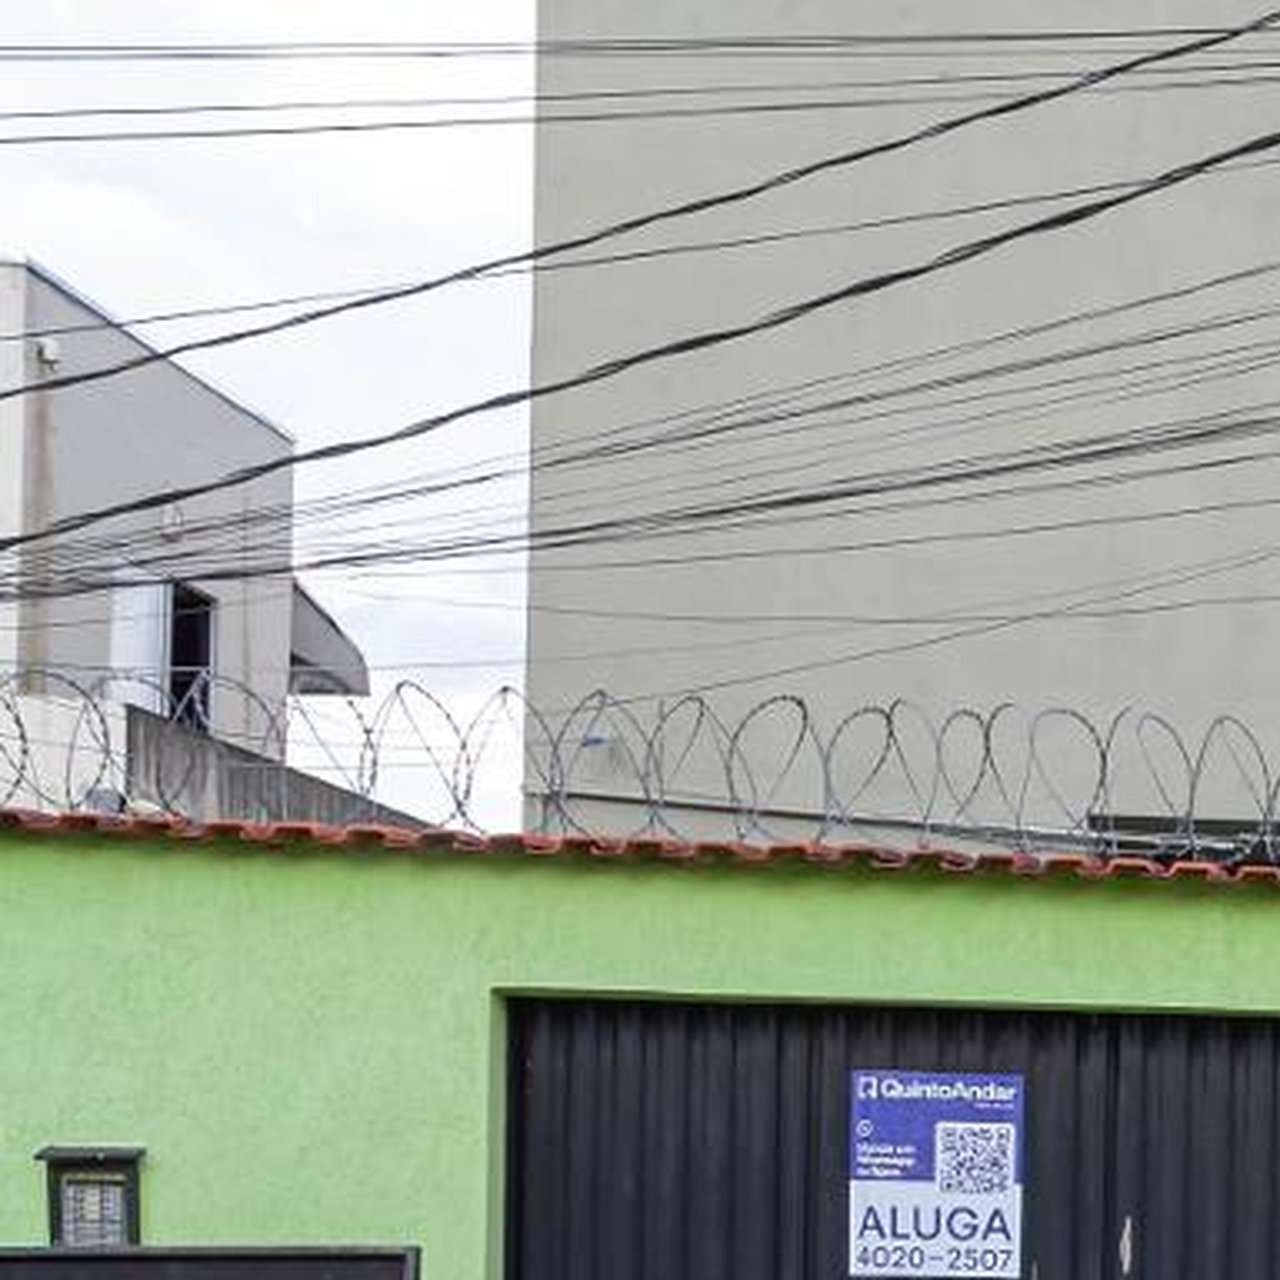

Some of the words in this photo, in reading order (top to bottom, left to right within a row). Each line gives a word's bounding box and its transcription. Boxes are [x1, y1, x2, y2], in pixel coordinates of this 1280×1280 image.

[880, 1078, 1016, 1100] QuintoAndar
[858, 1206, 1012, 1241] ALUGA
[857, 1246, 1013, 1271] 4020-2507
